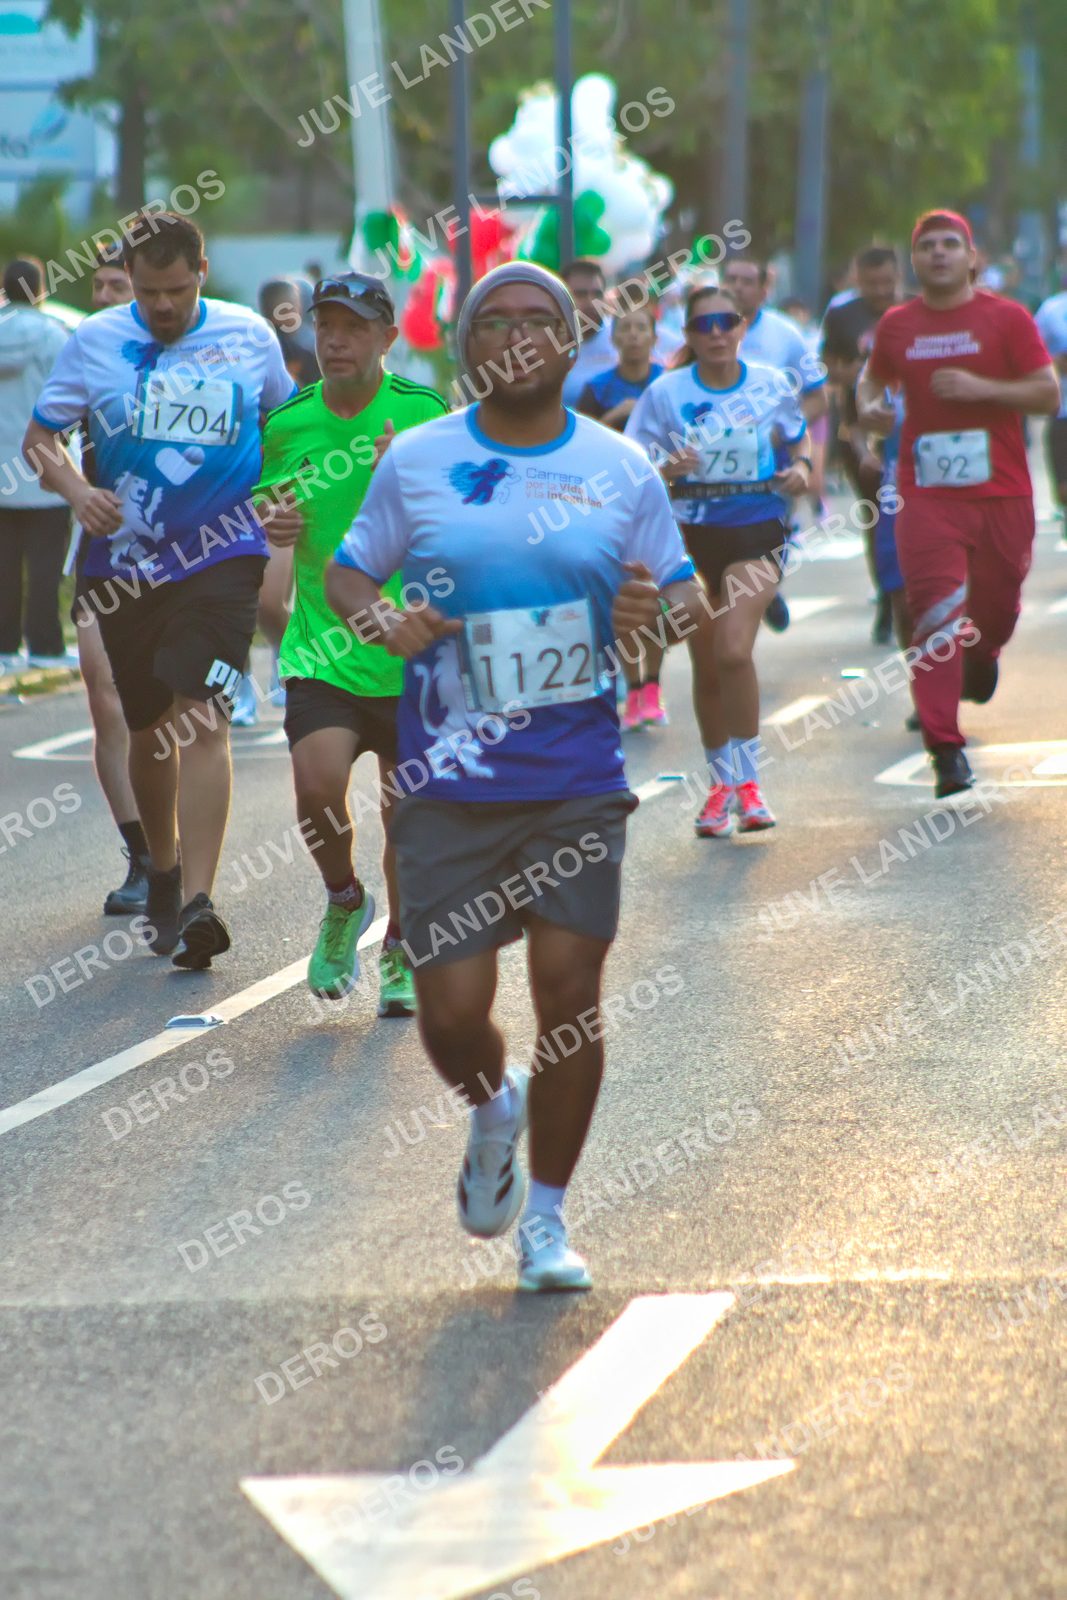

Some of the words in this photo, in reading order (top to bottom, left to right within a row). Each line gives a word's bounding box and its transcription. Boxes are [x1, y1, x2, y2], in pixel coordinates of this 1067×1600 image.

[152, 401, 228, 437] 1704
[705, 450, 738, 475] 75
[937, 456, 969, 480] 92
[480, 643, 592, 698] 1122
